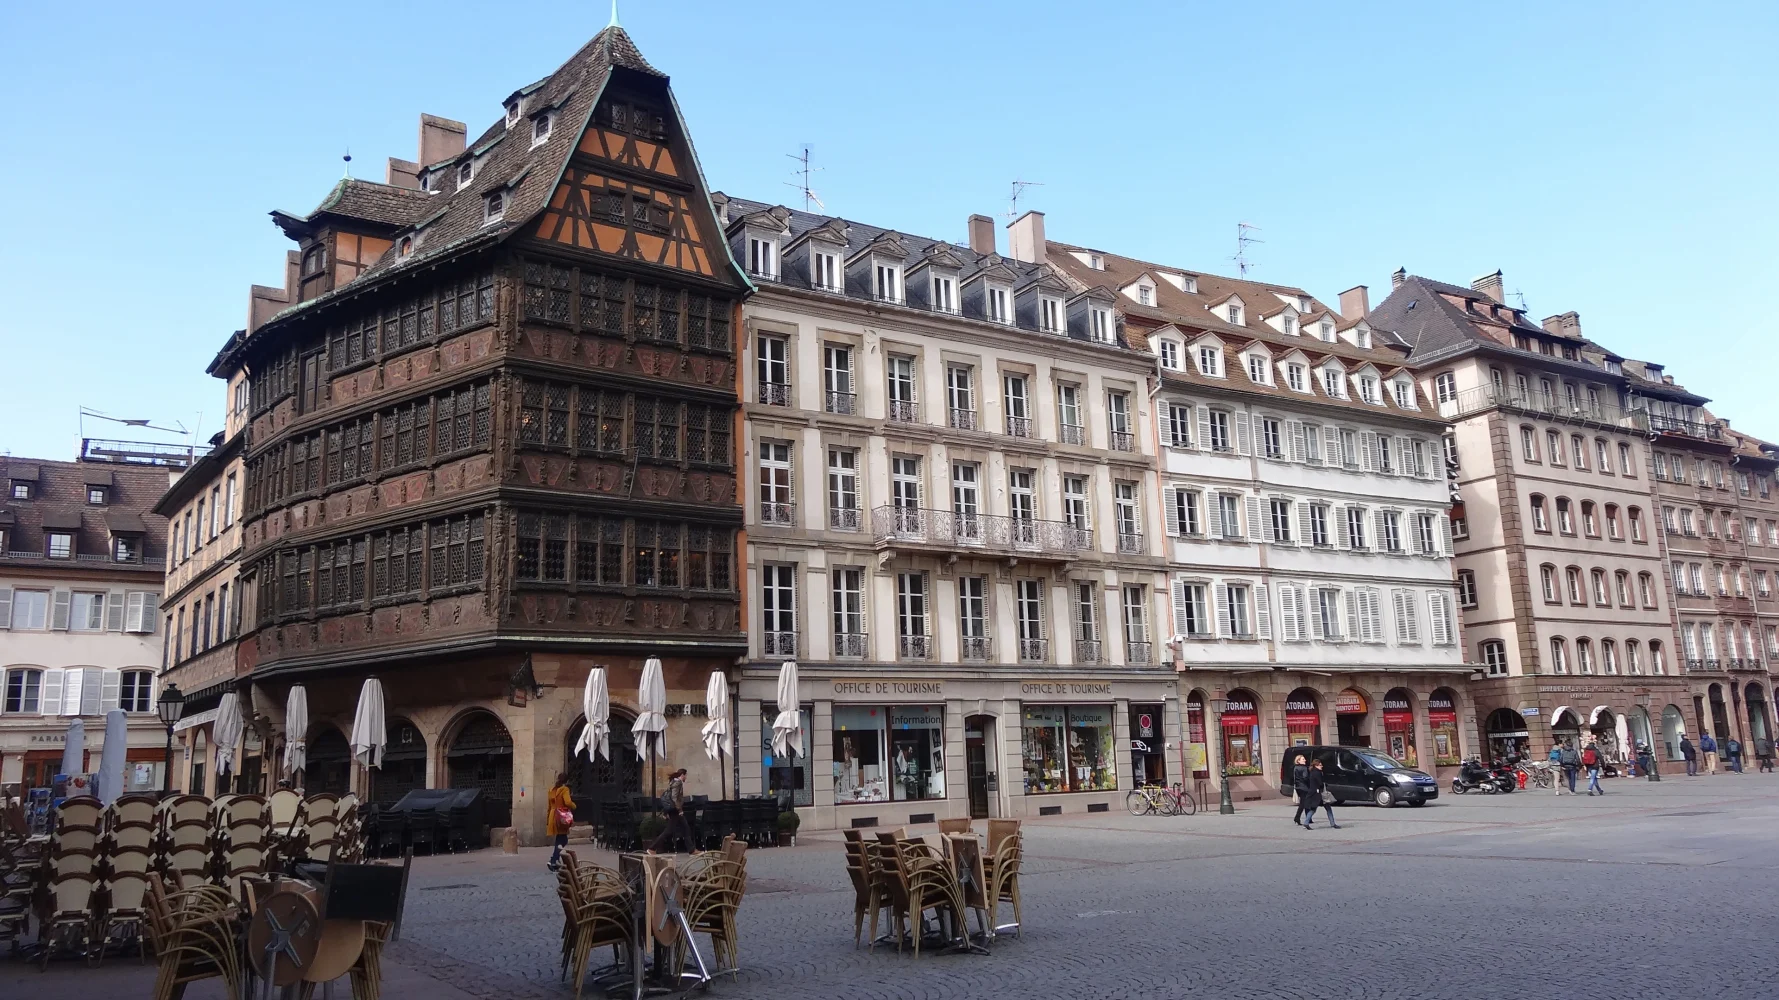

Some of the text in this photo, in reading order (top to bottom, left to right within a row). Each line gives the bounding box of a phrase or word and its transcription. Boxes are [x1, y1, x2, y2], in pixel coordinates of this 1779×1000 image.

[834, 683, 942, 694] OFFICE DE TOURISME
[1021, 683, 1112, 694] OFFICE DE TOURISME
[1226, 701, 1254, 710] TORAMA
[1286, 701, 1315, 710] ATORAMA
[1383, 700, 1409, 709] ATORAMA
[891, 715, 941, 725] Information
[1054, 713, 1102, 723] La Boutique
